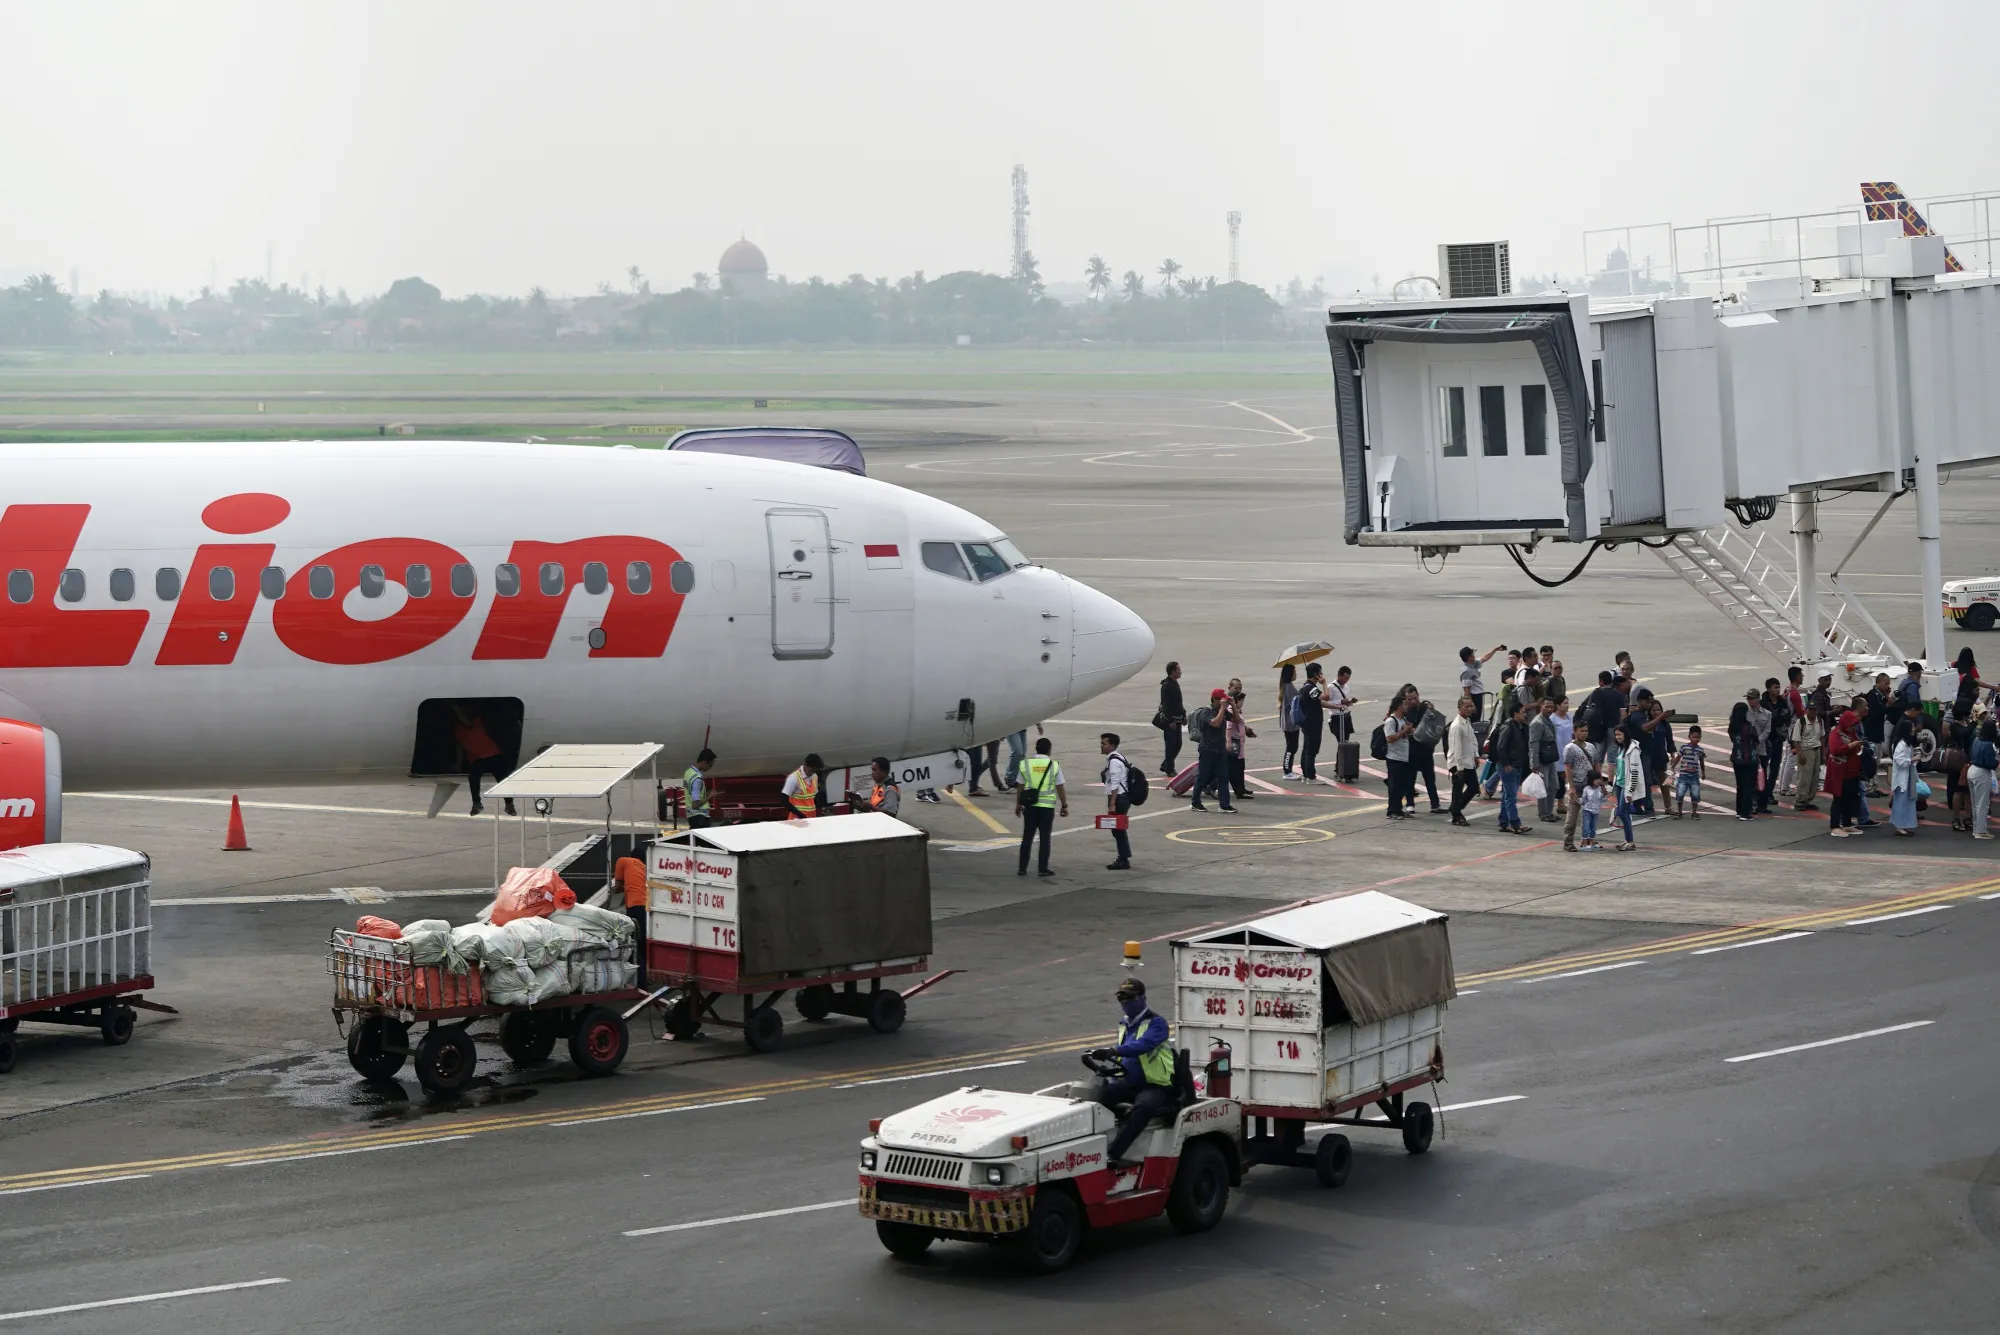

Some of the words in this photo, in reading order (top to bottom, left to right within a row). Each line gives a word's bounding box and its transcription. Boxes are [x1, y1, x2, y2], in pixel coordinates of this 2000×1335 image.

[0, 492, 686, 669] Lion
[658, 857, 683, 870] Lion
[697, 861, 733, 878] Group
[1190, 960, 1231, 977] Lion
[1254, 963, 1313, 982] Group
[1206, 997, 1227, 1015] BCC
[1203, 1107, 1218, 1121] 148
[1219, 1103, 1230, 1117] JT
[1045, 1159, 1066, 1174] Lion
[1076, 1151, 1102, 1167] Group
